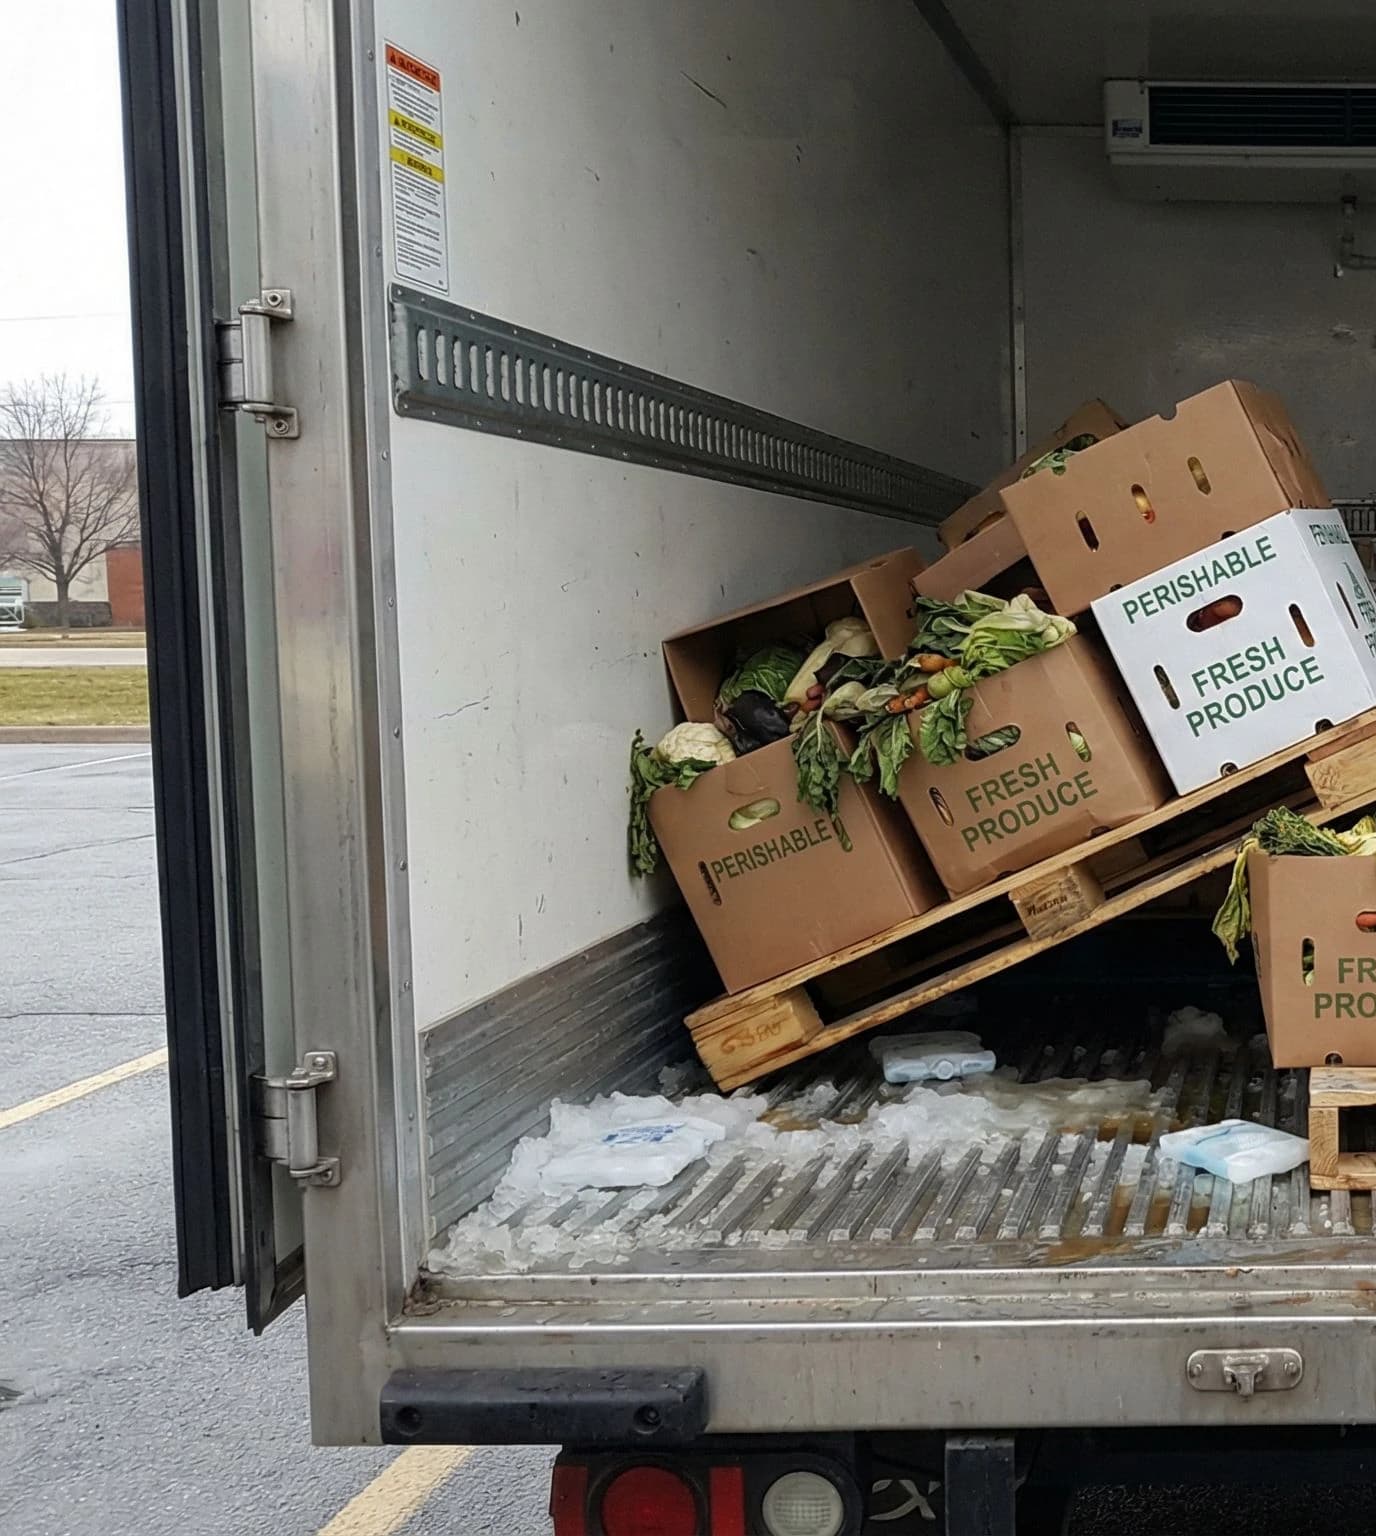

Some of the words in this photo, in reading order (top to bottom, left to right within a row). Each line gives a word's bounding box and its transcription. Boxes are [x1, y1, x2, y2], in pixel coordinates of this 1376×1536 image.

[1122, 535, 1277, 625] PERISHABLE
[1186, 655, 1325, 738] PRODUCE
[1192, 636, 1286, 696] FRESH
[960, 770, 1099, 853] PRODUCE
[964, 753, 1061, 814] FRESH
[710, 817, 832, 883] PERISHABLE
